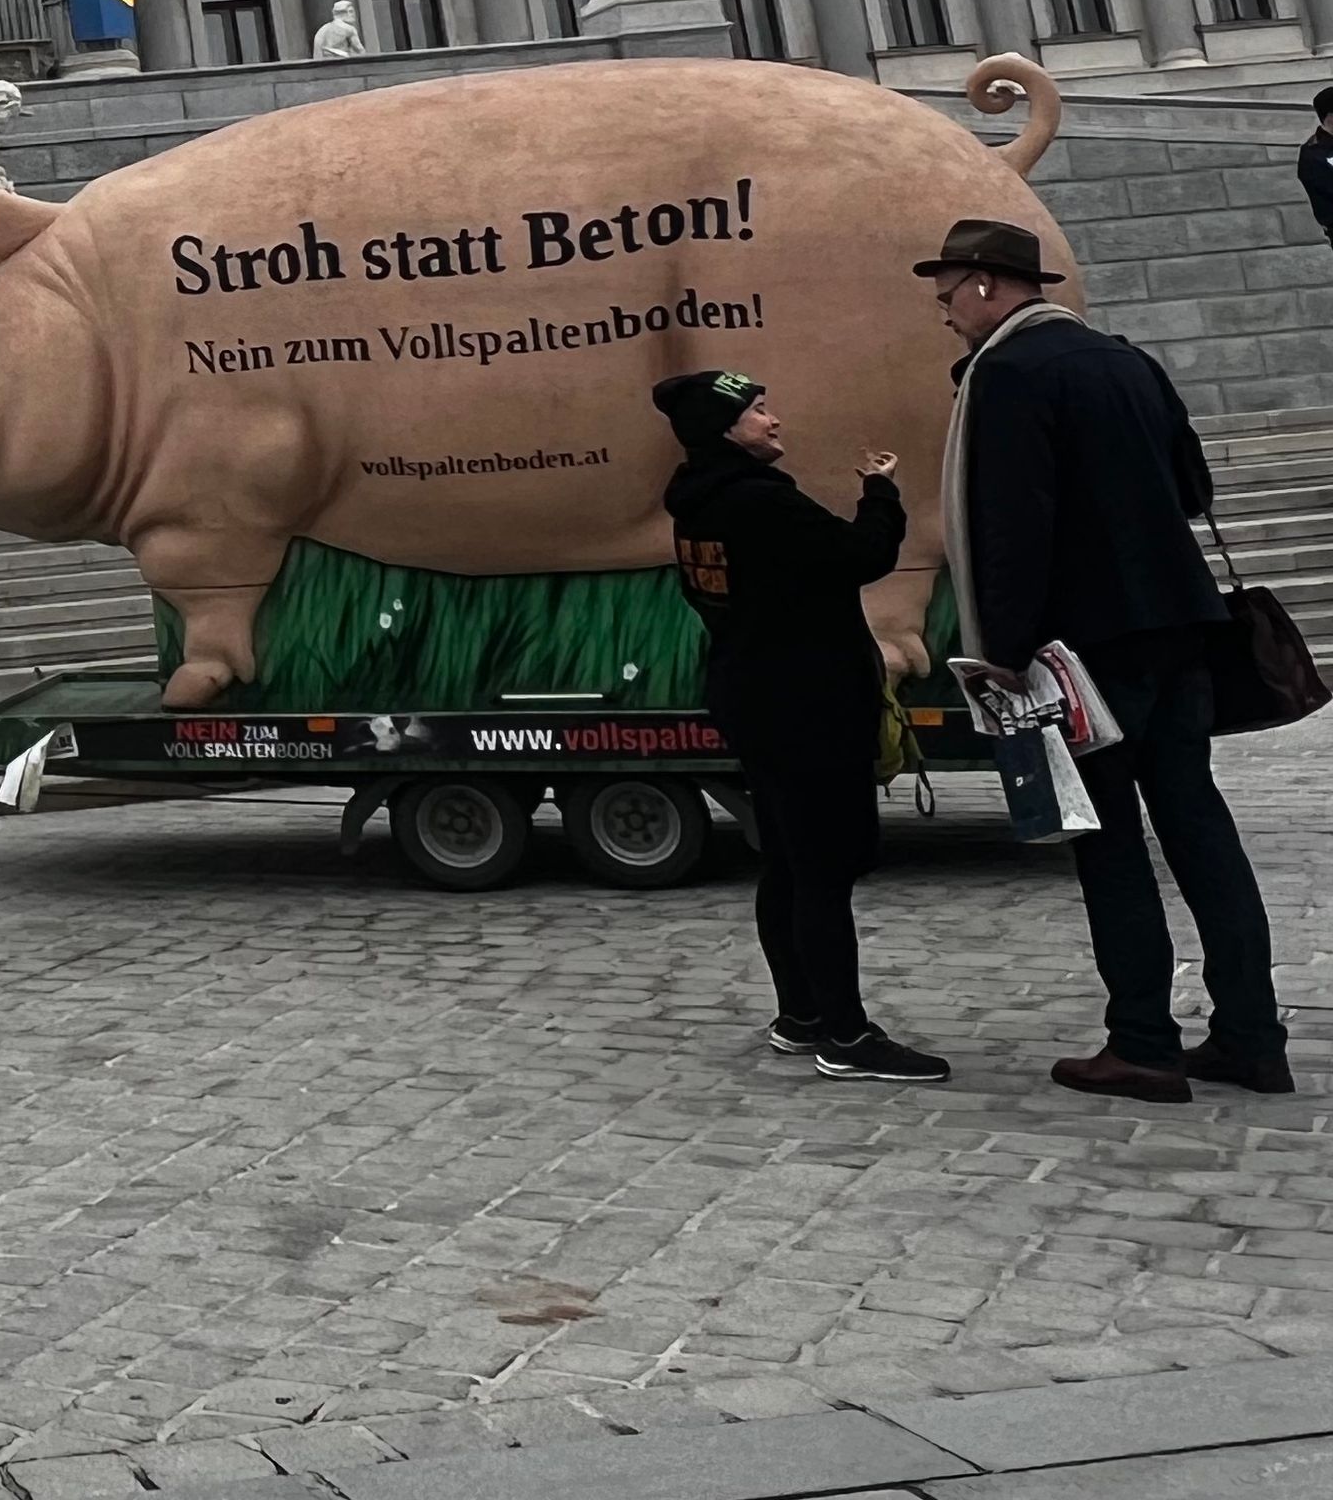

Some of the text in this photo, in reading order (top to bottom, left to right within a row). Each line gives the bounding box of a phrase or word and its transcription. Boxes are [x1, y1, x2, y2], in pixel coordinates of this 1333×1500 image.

[171, 178, 754, 295] Stroh statt Beton!
[184, 288, 764, 374] Nein zum Vollspaltenboden!
[359, 447, 611, 482] vollspaltenboden.at
[175, 721, 280, 741] NEIN ZUM
[471, 722, 728, 757] www.vollspalte
[163, 741, 333, 759] VOLLSPALTENBODEN
